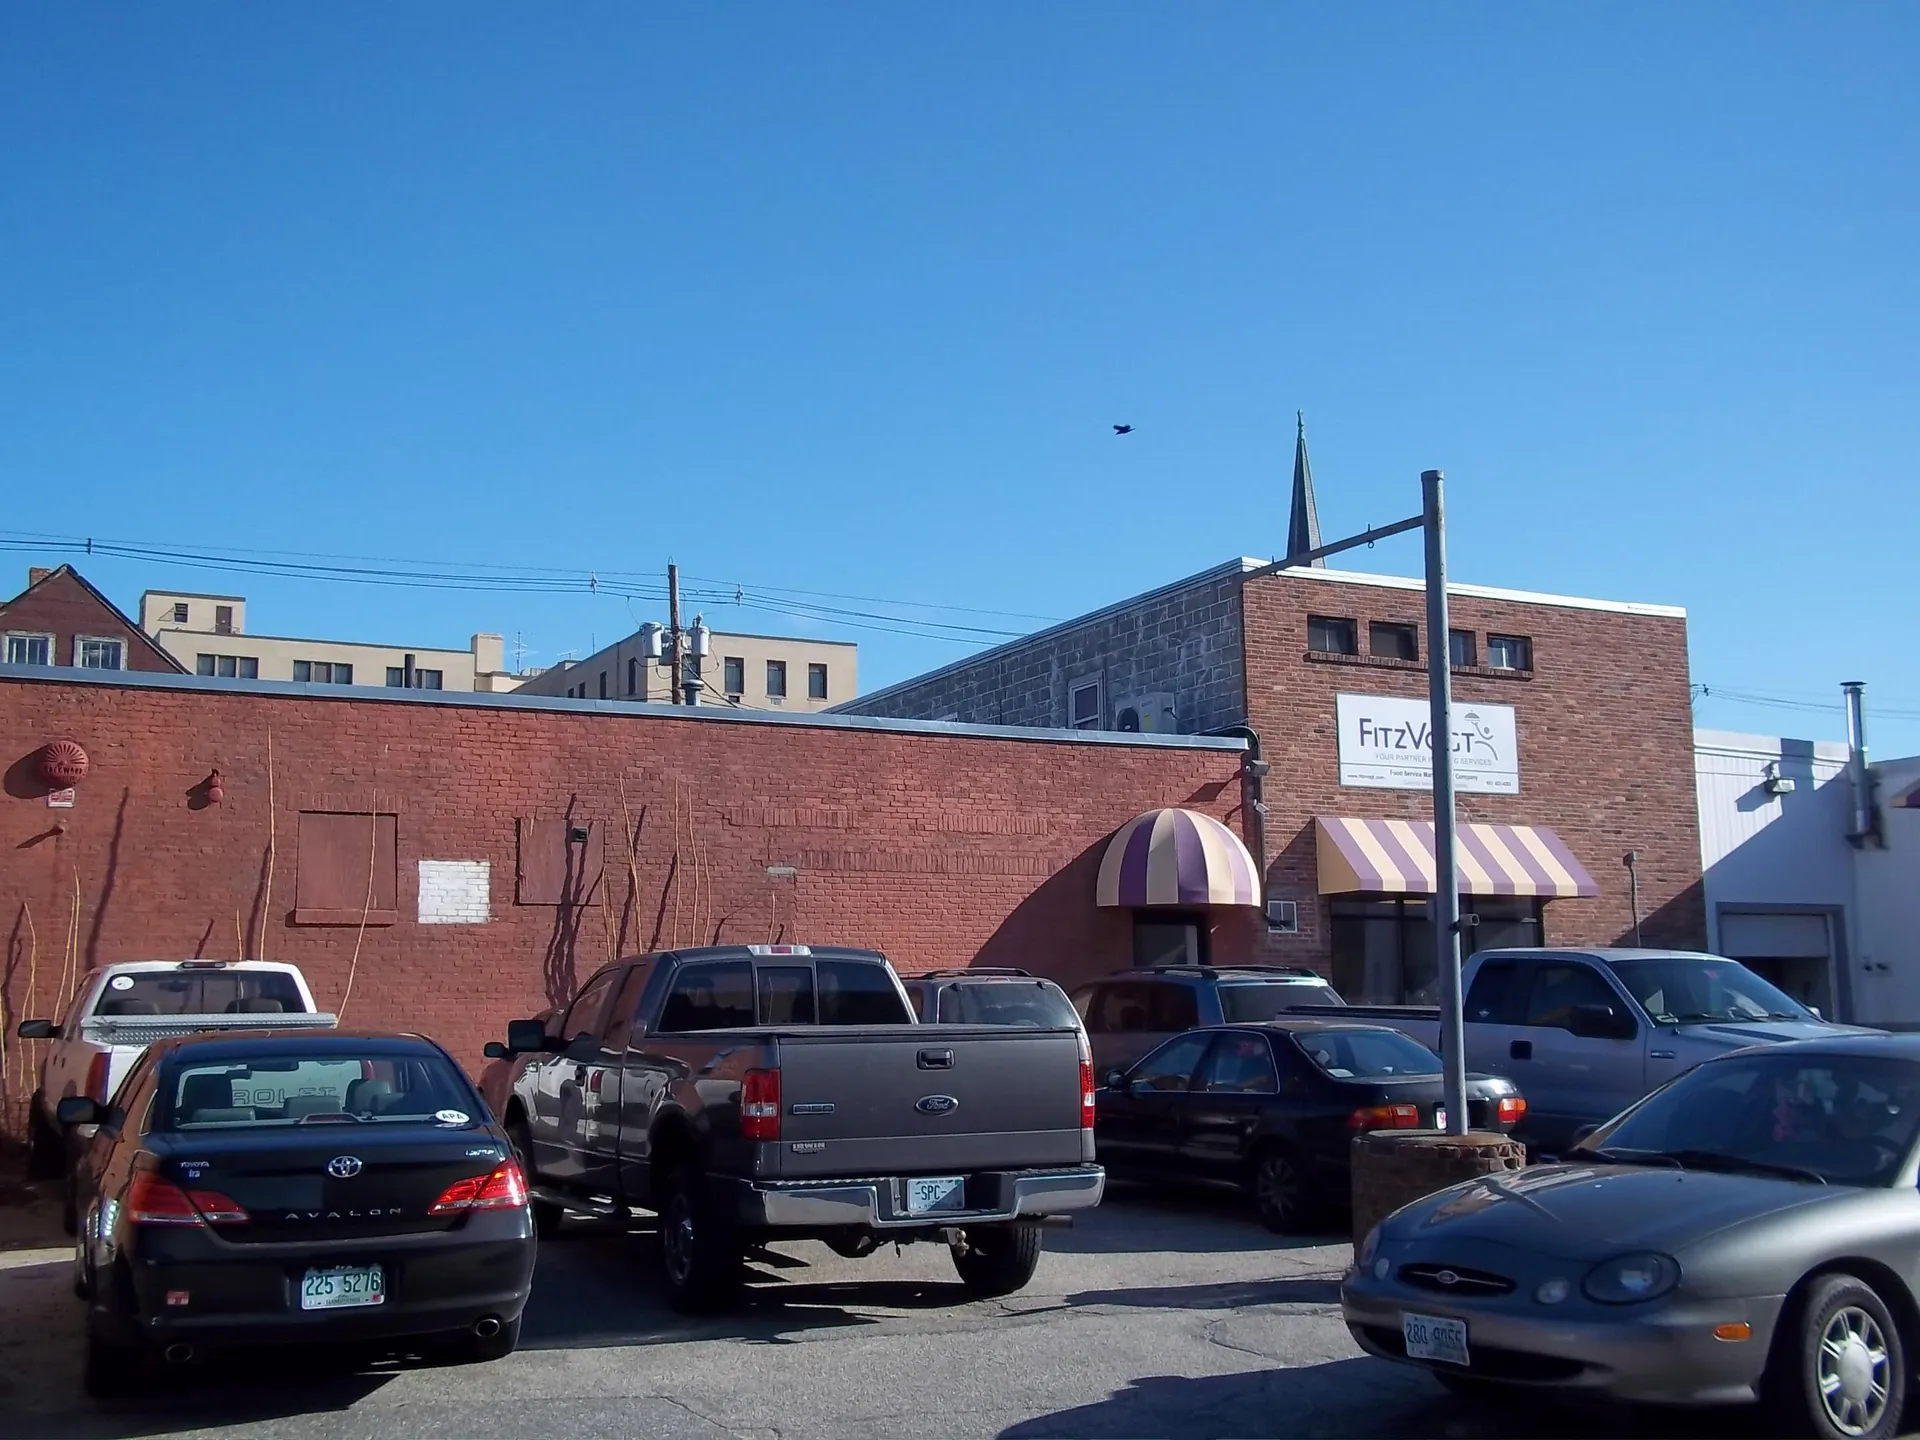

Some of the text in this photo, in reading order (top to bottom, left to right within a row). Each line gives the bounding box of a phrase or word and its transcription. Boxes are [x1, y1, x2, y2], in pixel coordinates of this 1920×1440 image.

[926, 1098, 951, 1110] Ford
[285, 1207, 401, 1220] AVALON
[306, 1272, 380, 1297] 225 5276
